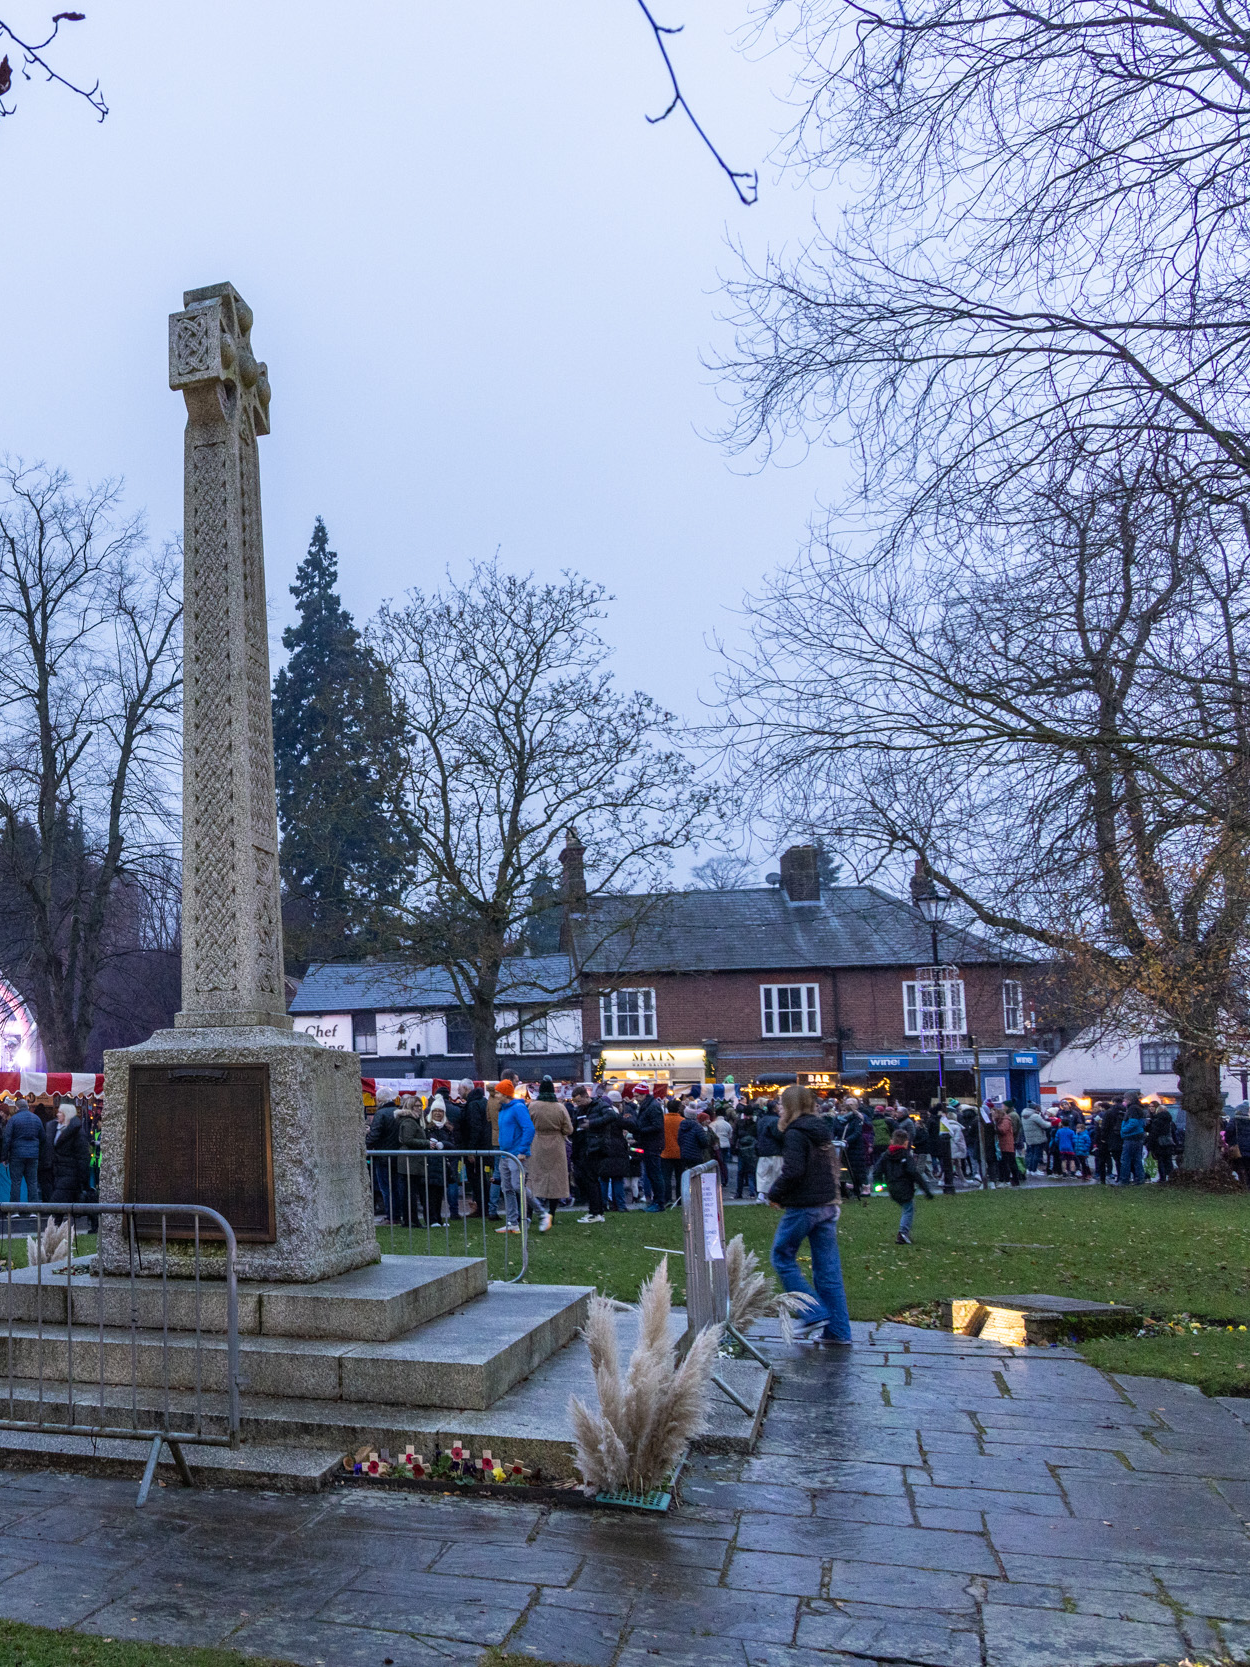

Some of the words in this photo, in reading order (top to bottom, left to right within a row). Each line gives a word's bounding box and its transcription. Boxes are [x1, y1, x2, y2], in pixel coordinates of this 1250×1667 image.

[305, 1024, 338, 1037] Chef
[632, 1052, 675, 1061] MAIN
[808, 1074, 831, 1083] BAR
